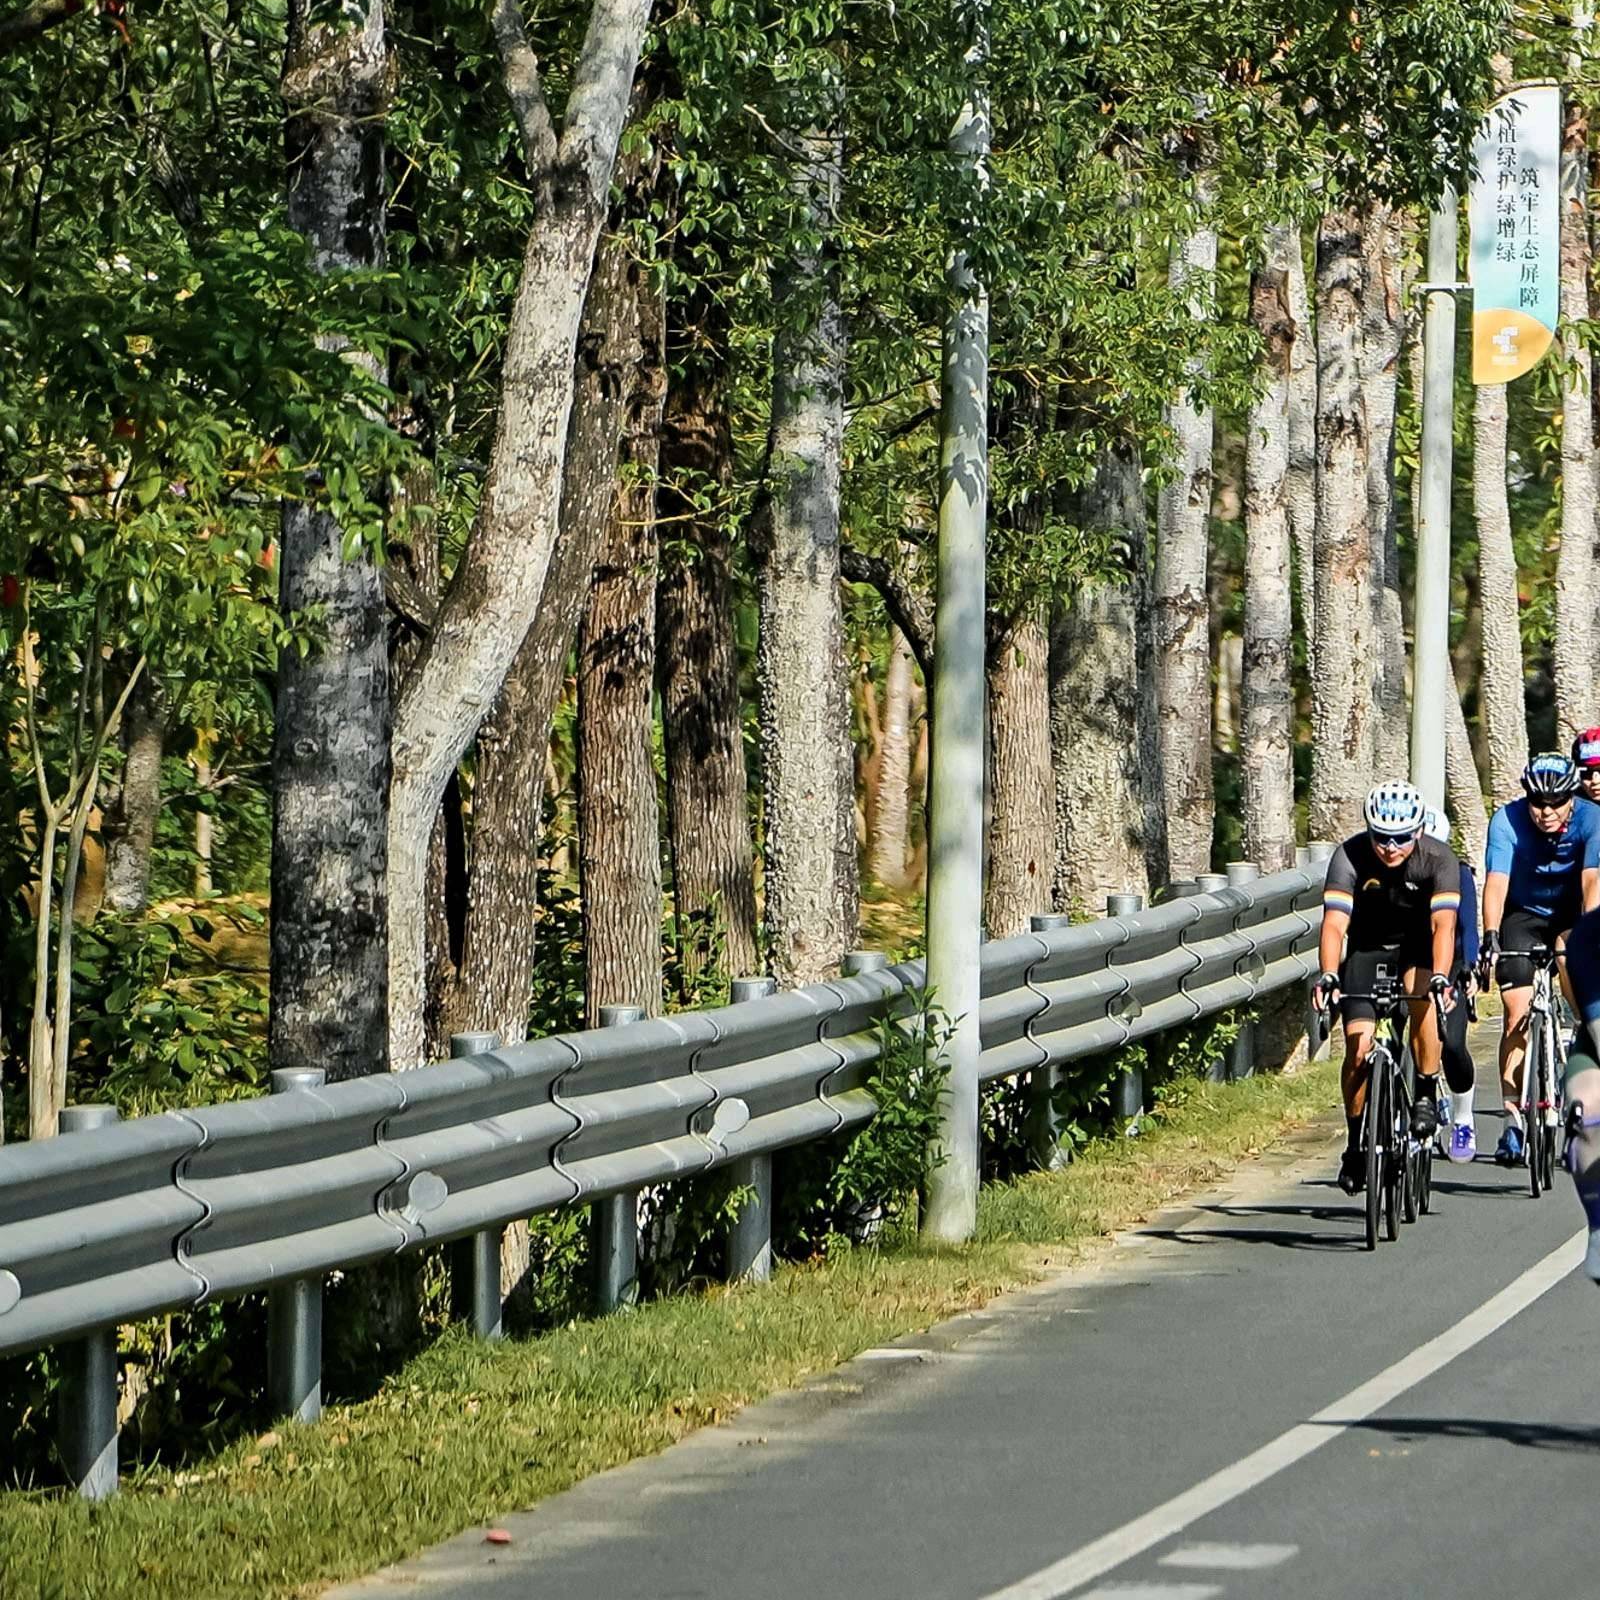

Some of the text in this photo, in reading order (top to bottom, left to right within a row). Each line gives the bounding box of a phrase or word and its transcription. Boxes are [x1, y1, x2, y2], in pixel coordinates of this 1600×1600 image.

[1496, 124, 1517, 263] 植绿护绿增绿
[1519, 167, 1540, 308] 筑牢生态屏障
